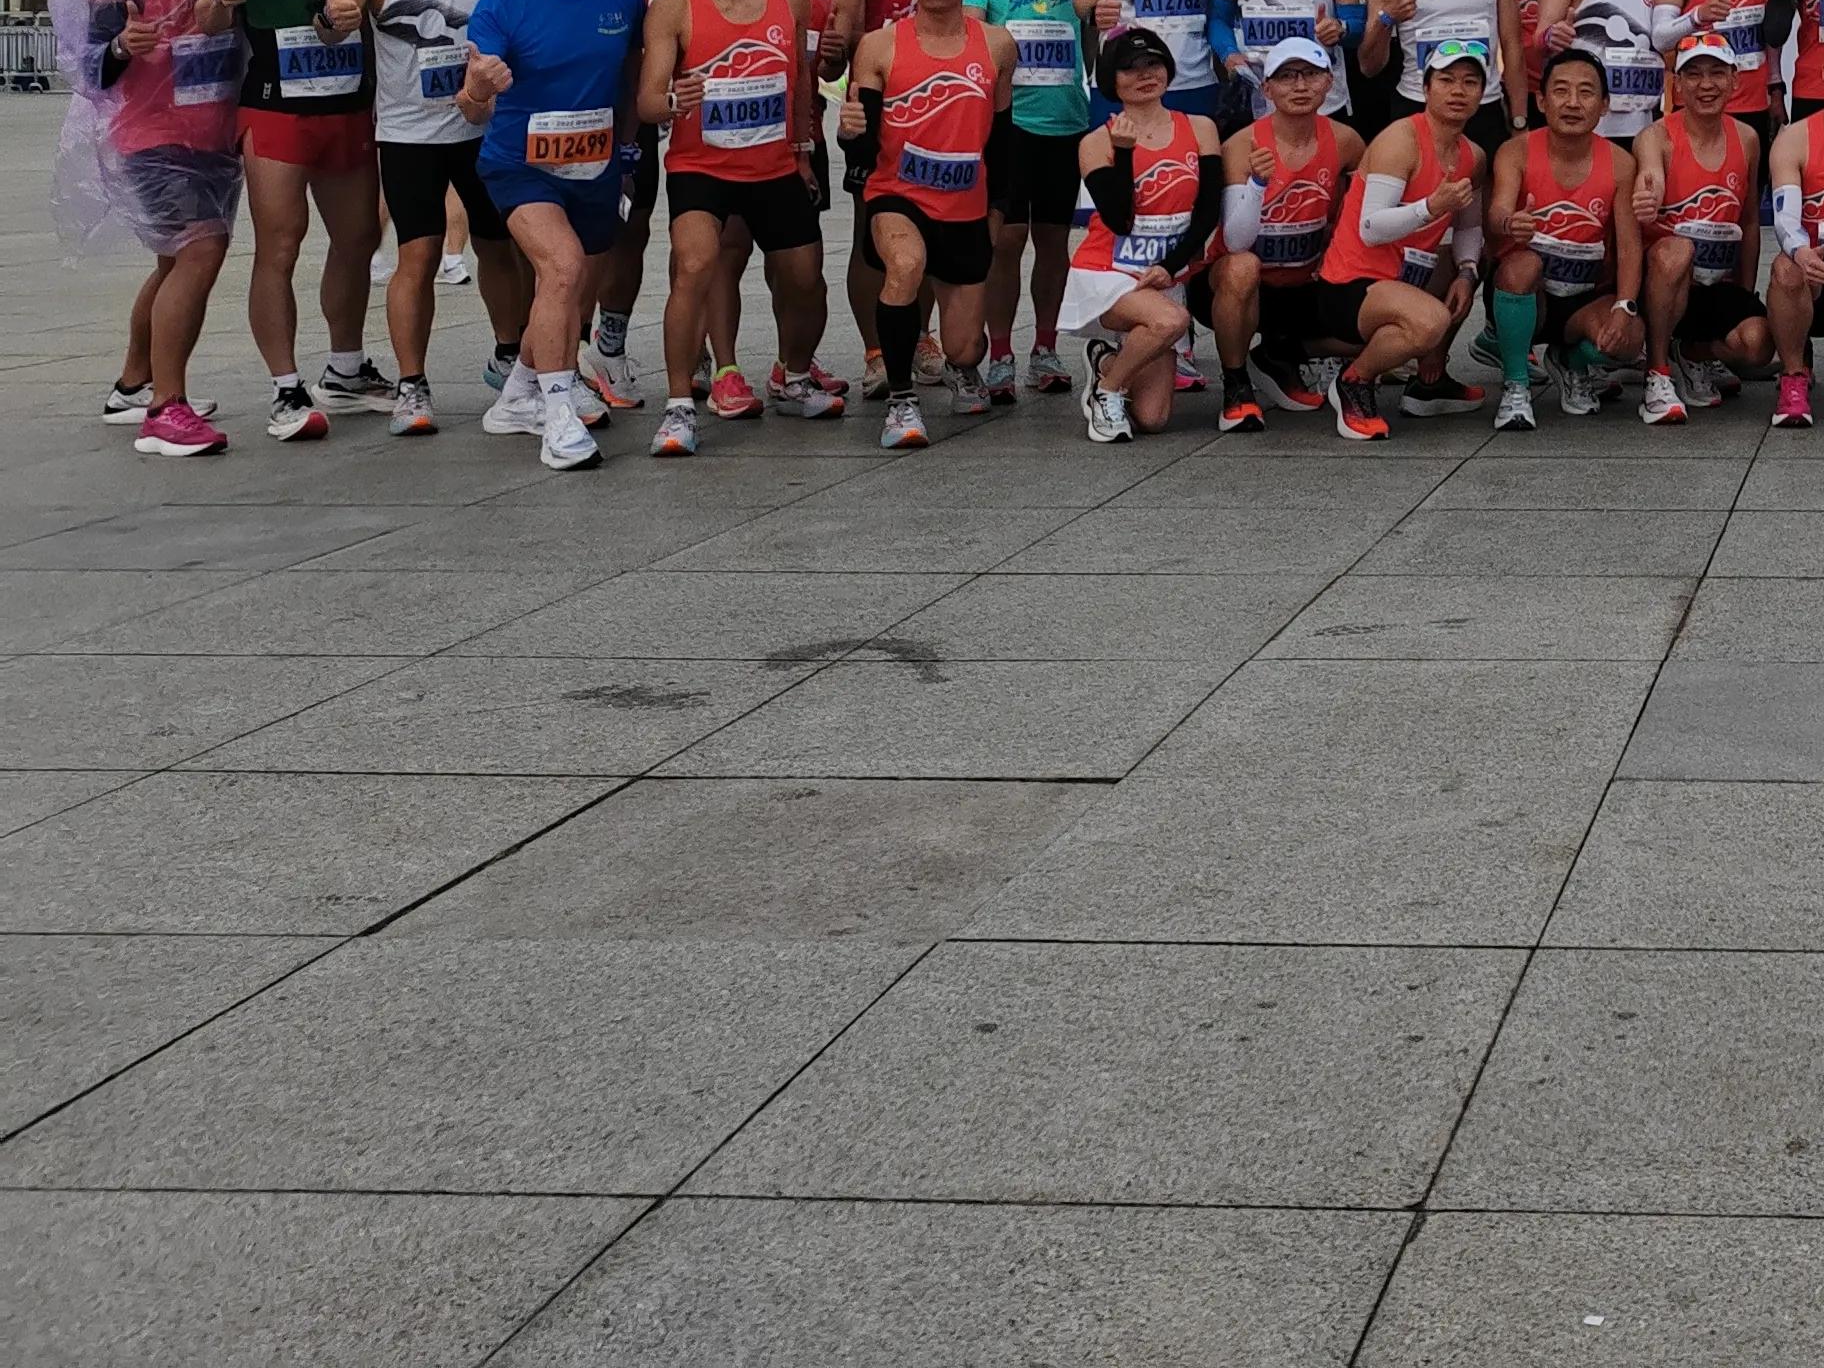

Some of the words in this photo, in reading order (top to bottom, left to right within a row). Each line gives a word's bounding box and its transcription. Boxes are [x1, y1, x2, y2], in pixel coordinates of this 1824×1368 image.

[1247, 19, 1309, 42] A10053
[708, 97, 785, 125] A10812
[535, 133, 609, 160] D12499
[904, 157, 975, 185] A11600
